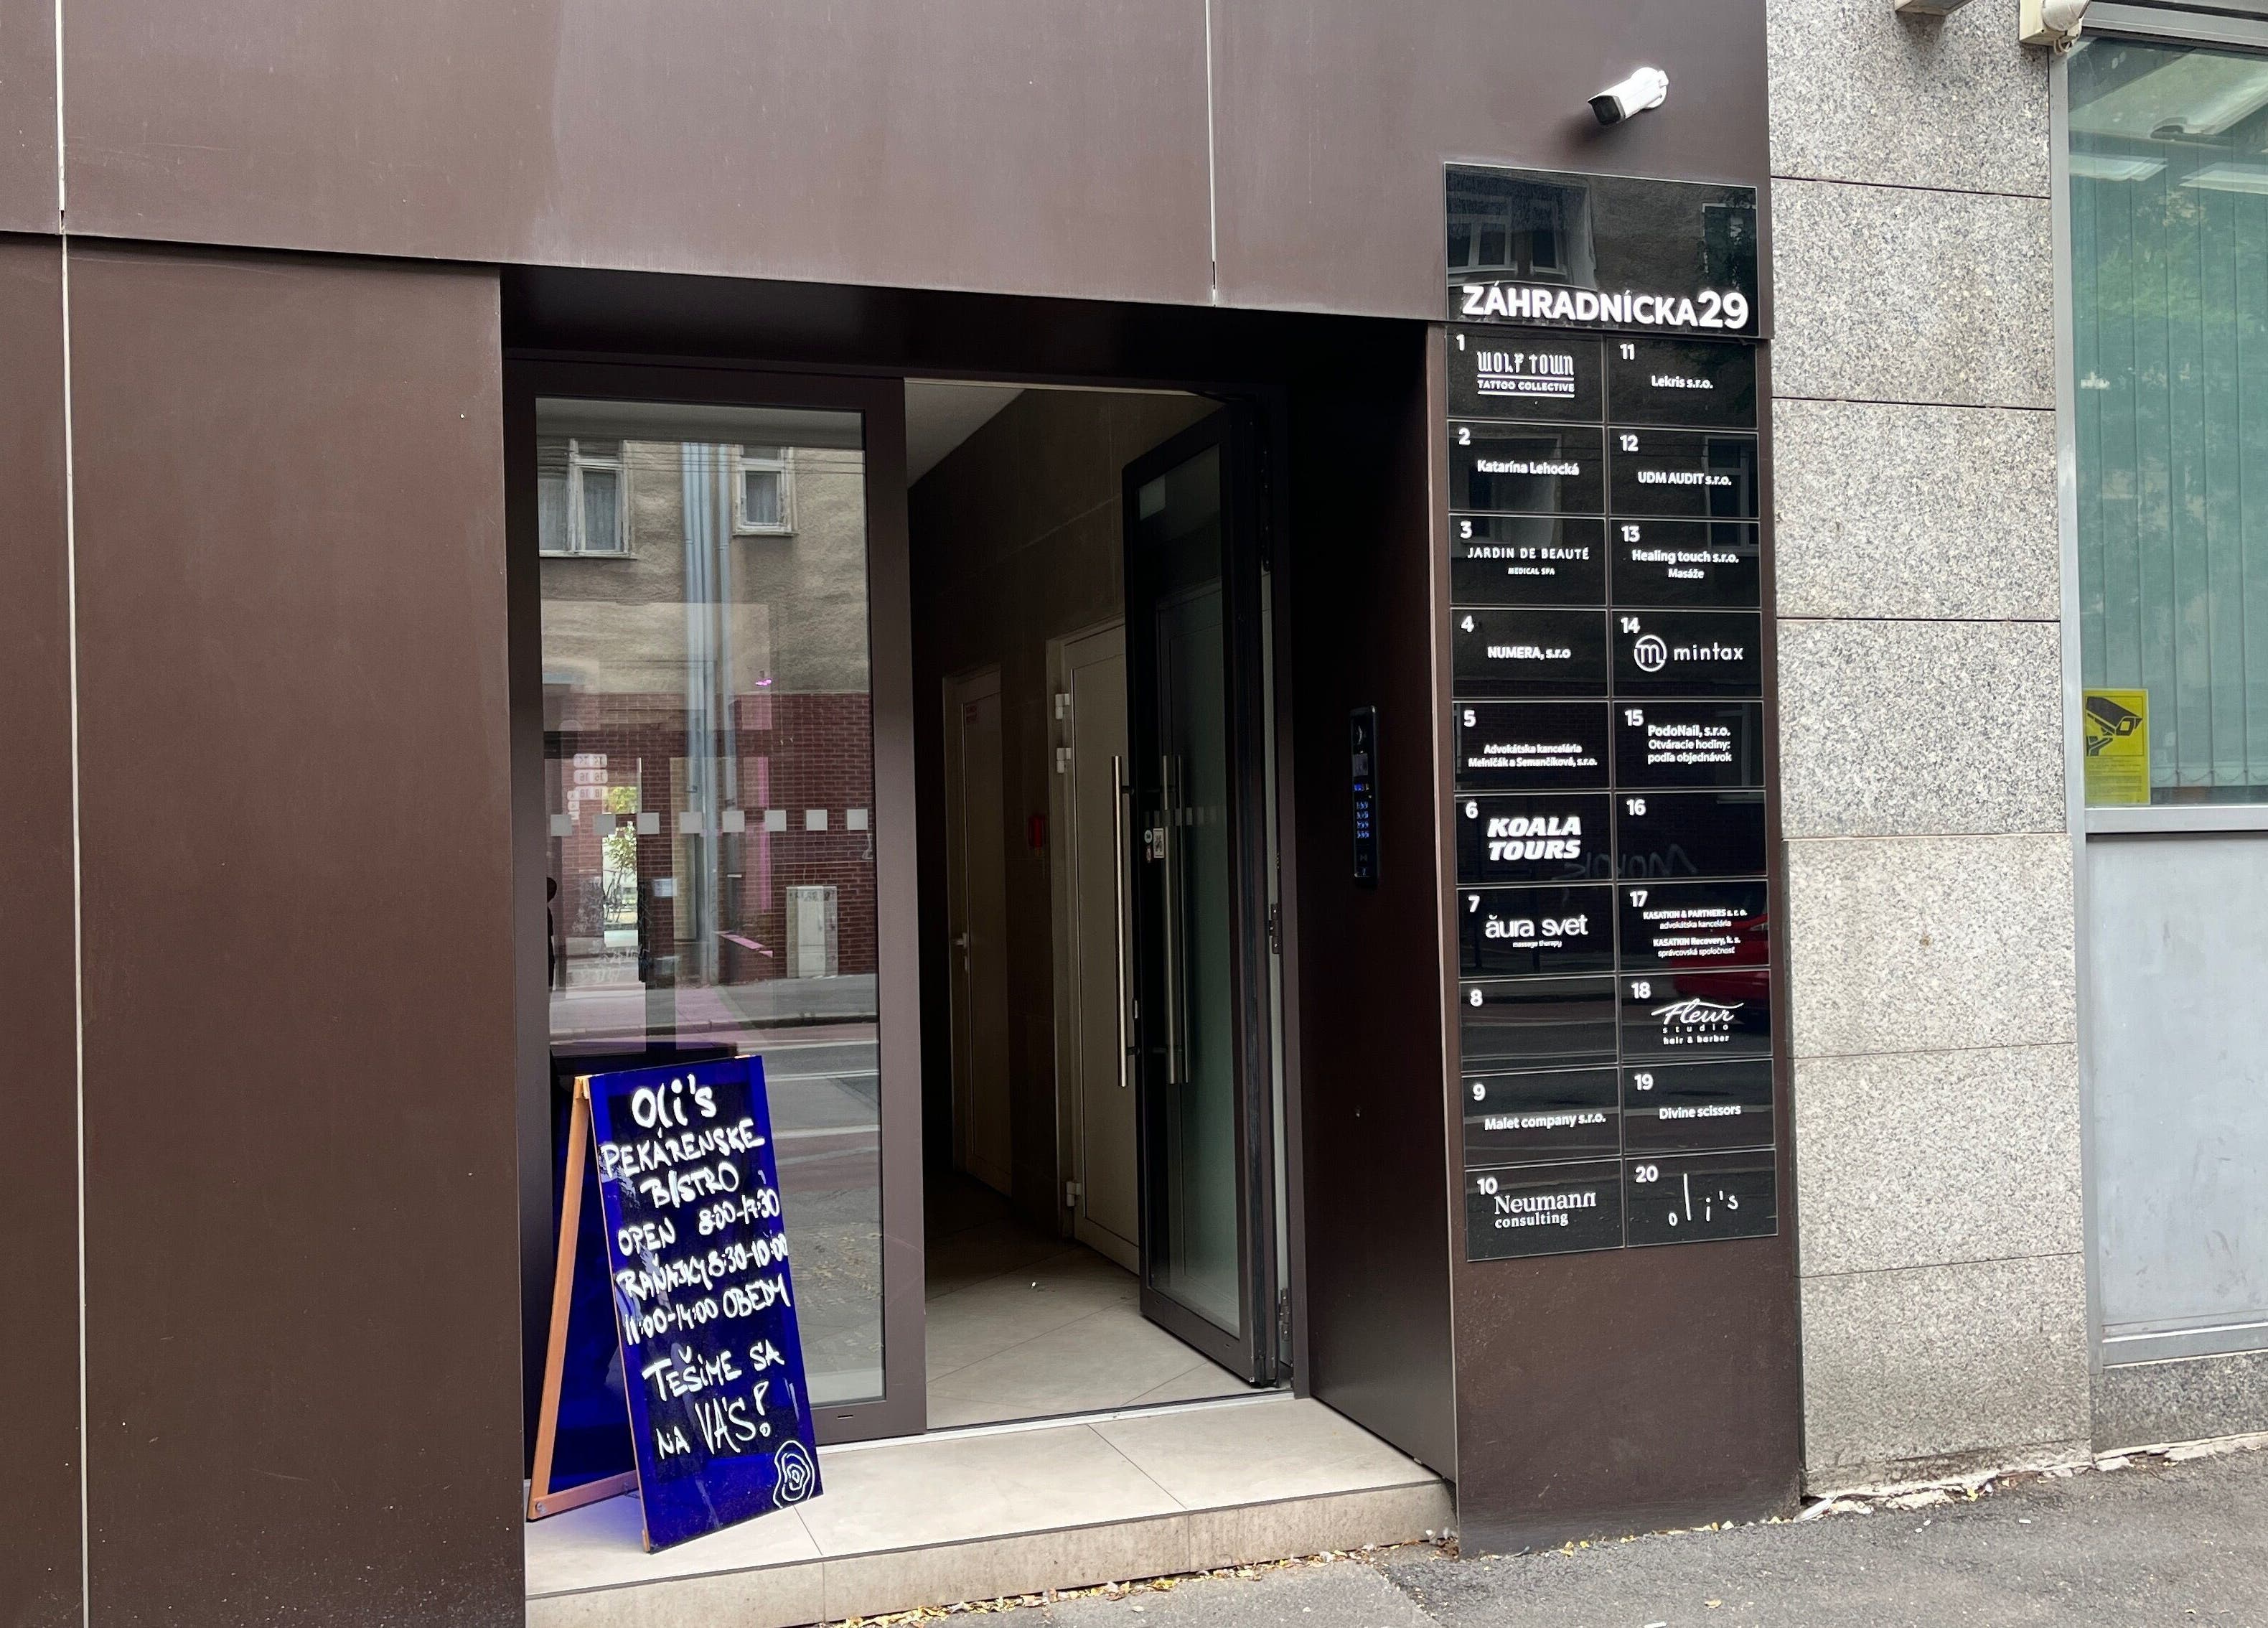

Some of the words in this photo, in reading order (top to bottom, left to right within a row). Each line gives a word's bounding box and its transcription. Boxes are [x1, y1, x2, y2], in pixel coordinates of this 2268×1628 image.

[1456, 334, 1466, 351] 1
[1619, 343, 1636, 360] 11
[1528, 352, 1575, 376] TOWN
[1477, 379, 1516, 390] TATTOO
[1517, 380, 1575, 393] COLLECTIVE
[1651, 375, 1685, 388] Lekris
[1686, 376, 1713, 389] s.r.o.
[1458, 427, 1471, 446] 2
[1619, 434, 1639, 452] 12
[1477, 459, 1528, 474] Katarína
[1529, 462, 1580, 475] Lehocká
[1637, 471, 1667, 484] UDM
[1667, 472, 1705, 485] AUDIT
[1705, 473, 1732, 486] s.r.o.
[1459, 520, 1473, 539] 3
[1621, 525, 1641, 543] 13
[1467, 546, 1515, 558] JARDIN
[1519, 547, 1537, 559] DE
[1541, 546, 1590, 561] BEAUTÉ
[1631, 549, 1677, 564] Healing
[1677, 550, 1711, 563] touch
[1712, 551, 1739, 563] s.r.o.
[1507, 566, 1540, 576] MEDICAL
[1540, 567, 1555, 576] SPA
[1667, 568, 1705, 579] Masáže
[1461, 615, 1474, 632] 4
[1620, 617, 1641, 634] 14
[1487, 645, 1545, 661] NUMERA,
[1545, 646, 1572, 659] s.r.o
[1674, 642, 1744, 662] mintax
[1463, 709, 1477, 727] 5
[1624, 709, 1644, 726] 15
[1647, 724, 1703, 738] PodoNail,
[1703, 726, 1731, 736] s.r.o.
[1648, 739, 1695, 749] Otváracie
[1676, 752, 1733, 764] objednávok
[1465, 801, 1479, 818] 6
[1626, 798, 1646, 816] 16
[1486, 815, 1582, 838] KOALA
[1488, 839, 1581, 861] TOURS
[1468, 895, 1480, 912] 7
[1629, 890, 1649, 907] 17
[1643, 910, 1680, 920] KASATKIN
[1687, 909, 1727, 918] PARTNERS
[1542, 914, 1588, 937] svet
[1470, 988, 1483, 1007] 8
[1631, 981, 1651, 999] 18
[1651, 998, 1744, 1026] Fleur
[1663, 1036, 1684, 1045] hair
[1697, 1034, 1730, 1045] barber
[1634, 1074, 1654, 1091] 19
[1472, 1083, 1486, 1101] 9
[1659, 1106, 1696, 1120] Divine
[1697, 1105, 1742, 1118] scissors
[1484, 1117, 1520, 1131] Malet
[1521, 1114, 1576, 1131] company
[1578, 1113, 1607, 1125] s.r.o.
[1635, 1165, 1659, 1183] 20
[639, 1161, 739, 1209] BISTRO
[1477, 1177, 1498, 1195] 10
[1494, 1191, 1597, 1215] Neumann
[1494, 1210, 1569, 1229] consulting
[618, 1217, 676, 1256] OPEN
[723, 1273, 792, 1319] OBEDY
[749, 1339, 784, 1372] SA
[655, 1425, 691, 1459] NA
